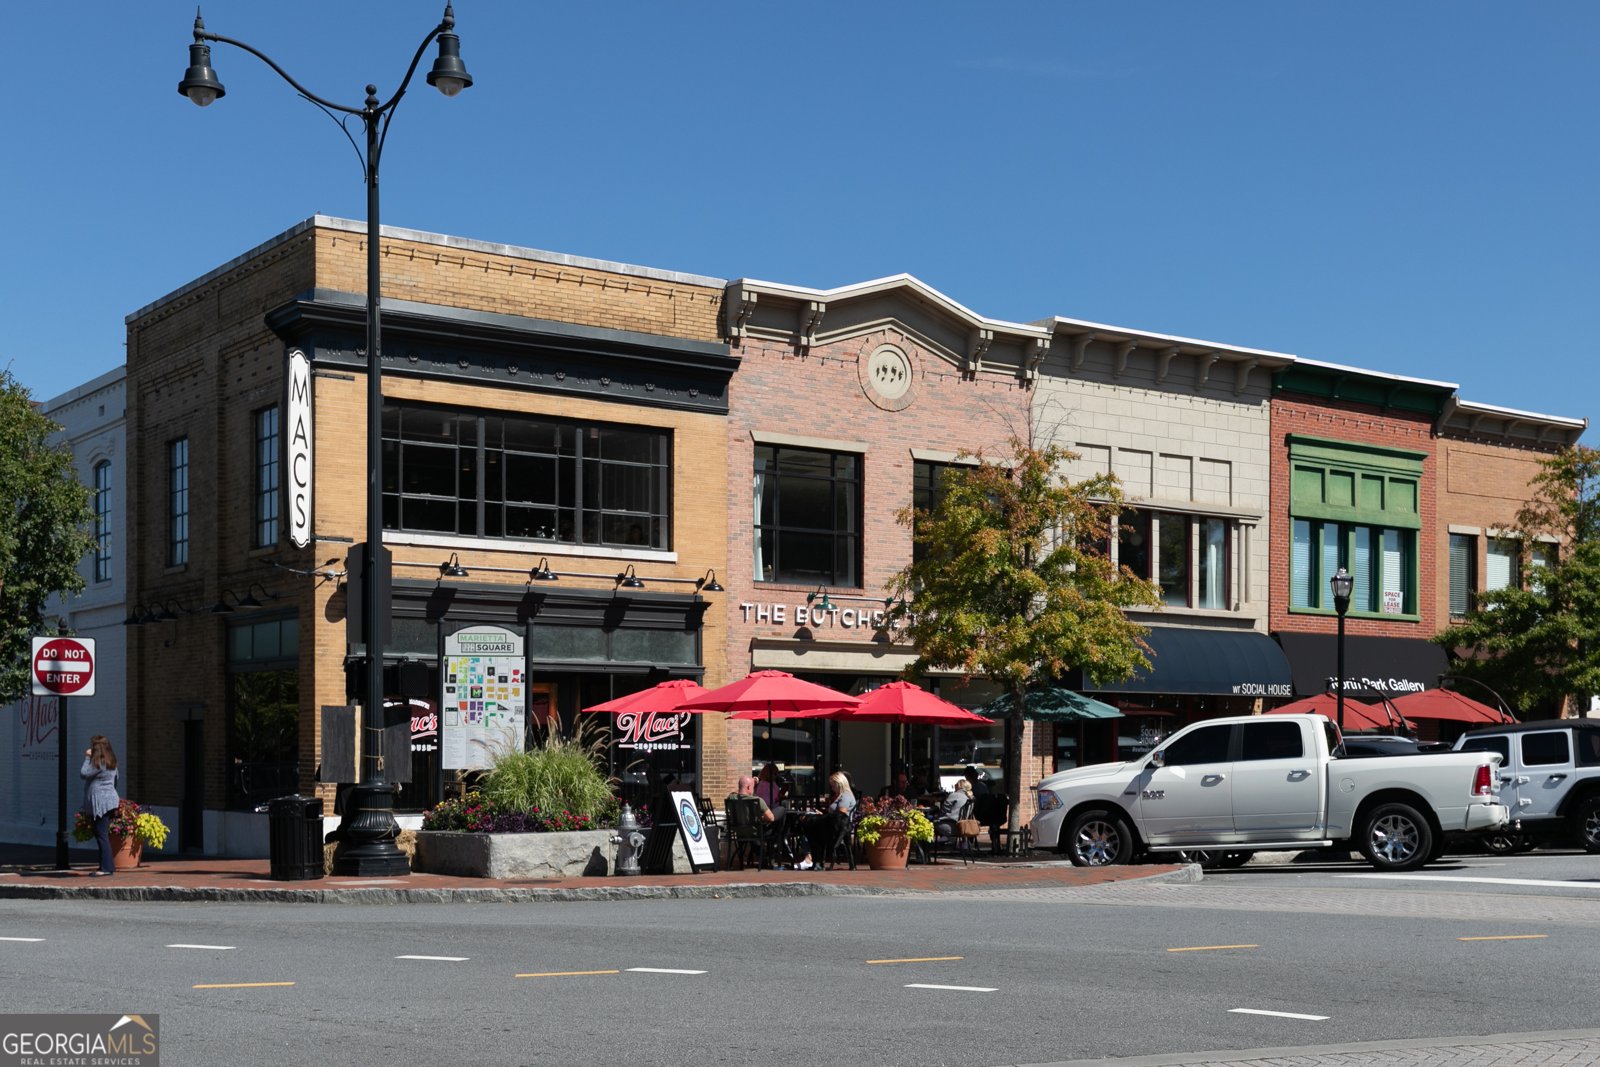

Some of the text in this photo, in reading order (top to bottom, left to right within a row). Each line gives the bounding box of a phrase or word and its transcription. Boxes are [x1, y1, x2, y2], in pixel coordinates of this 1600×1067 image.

[291, 372, 309, 529] MACS
[740, 603, 786, 622] THE
[460, 634, 504, 642] MARIETTA
[43, 649, 86, 659] DO NOT
[46, 673, 81, 684] ENTER
[1361, 677, 1388, 691] Park
[1388, 678, 1425, 693] Gallery
[1241, 683, 1267, 695] SOCIAL
[1267, 684, 1291, 696] HOUSE
